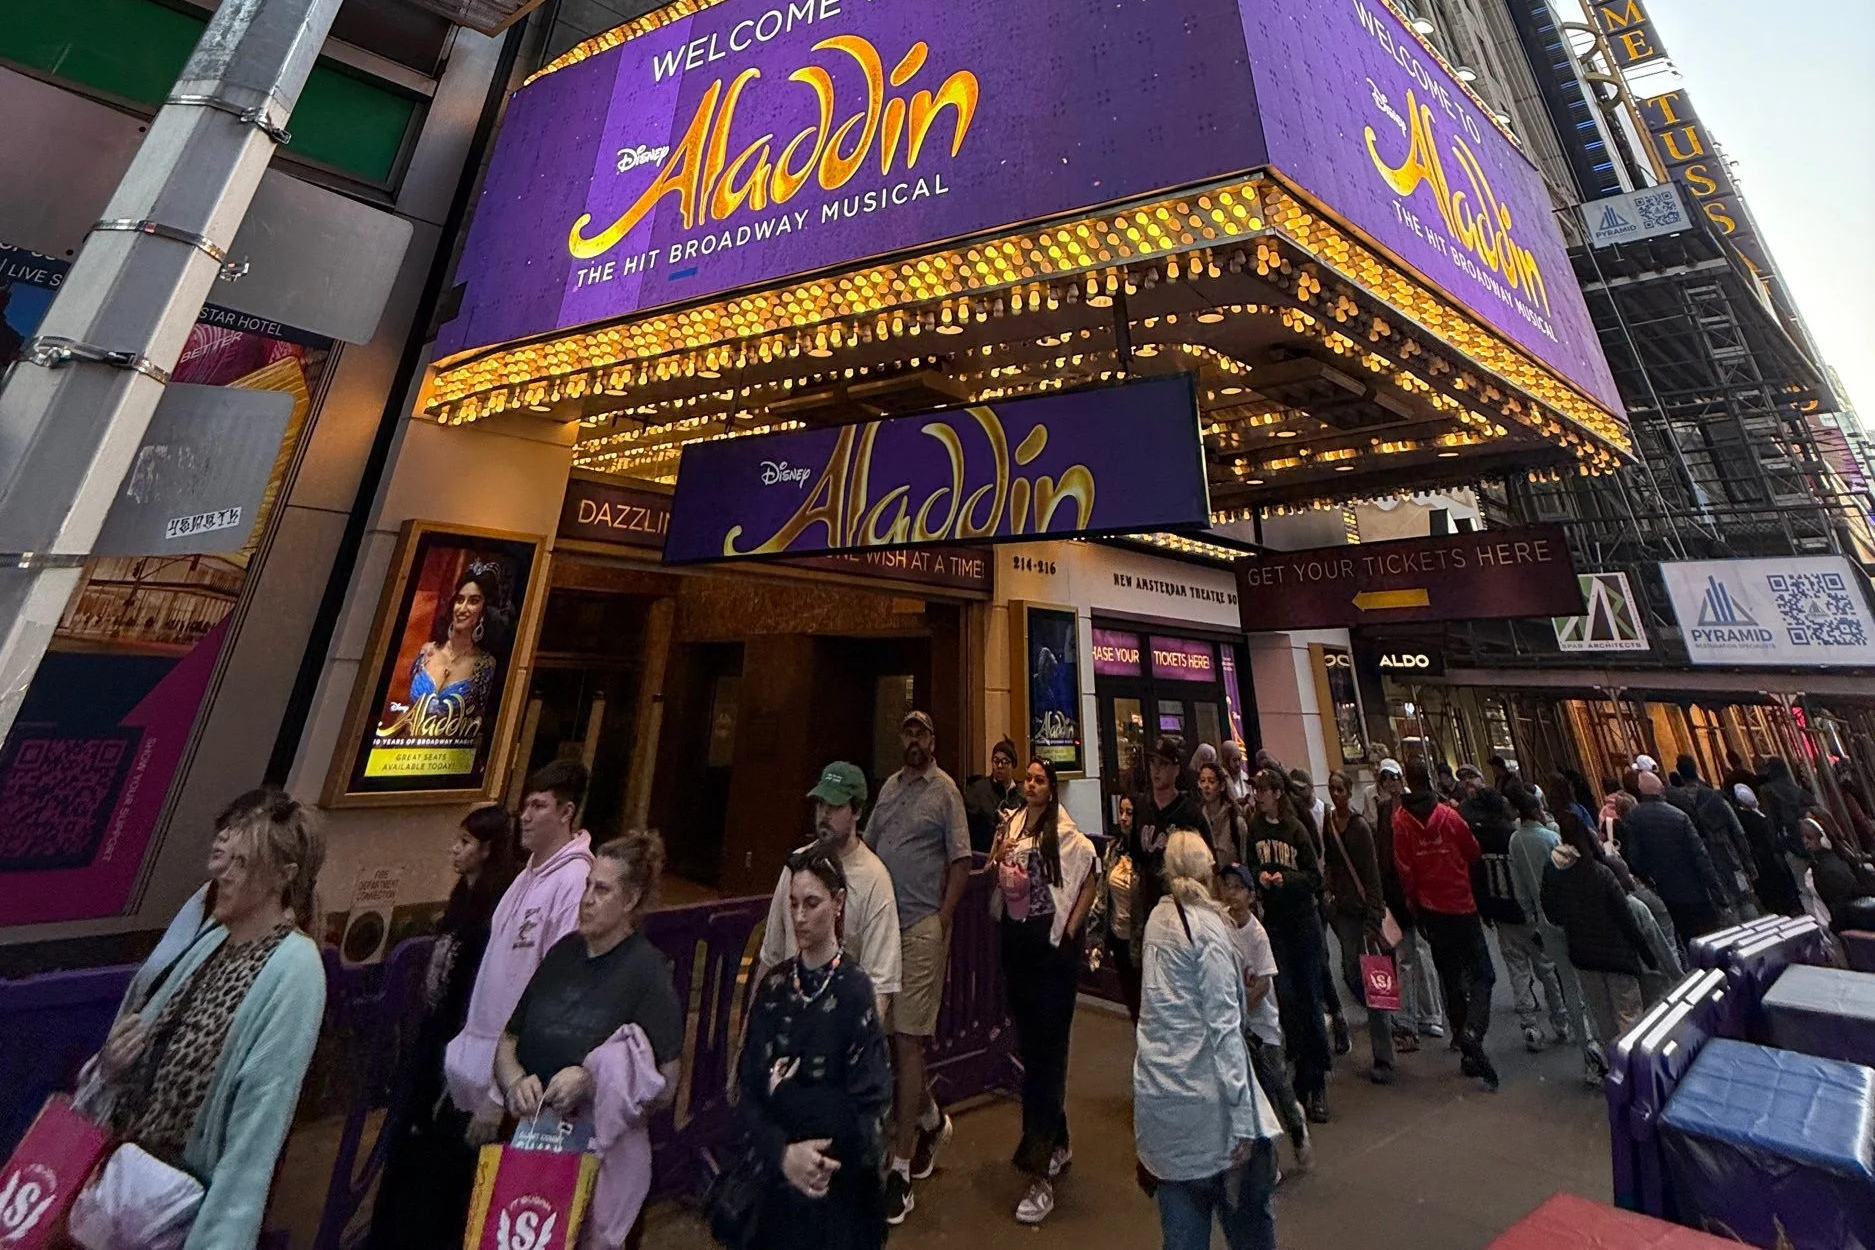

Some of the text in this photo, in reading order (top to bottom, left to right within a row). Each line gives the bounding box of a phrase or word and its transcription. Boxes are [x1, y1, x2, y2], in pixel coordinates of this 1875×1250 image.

[1455, 101, 1481, 145] TO
[568, 34, 980, 259] Aladdin
[1364, 88, 1552, 318] Aladdin
[577, 174, 949, 288] THE HIT BROADWAY MUSICAL
[1595, 225, 1637, 239] PYRAMID
[7, 264, 48, 283] LIVE
[1393, 199, 1559, 344] THE HIT BROADWAY MUSICAL
[199, 307, 283, 336] STAR HOTEL
[180, 331, 243, 363] BETTER
[723, 406, 1096, 557] Aladdin
[911, 551, 930, 571] AT
[934, 555, 945, 574] A
[1249, 540, 1552, 586] GET YOUR TICKETS HERE
[1113, 573, 1132, 587] NEW
[1136, 577, 1187, 597] AMSTERDAM
[1190, 586, 1225, 604] THEATRE
[1691, 629, 1773, 642] PYRAMID
[1115, 648, 1140, 663] YOUR
[1154, 650, 1187, 667] TICKETS
[1380, 654, 1430, 668] ALDO
[376, 692, 482, 737] Aladdin
